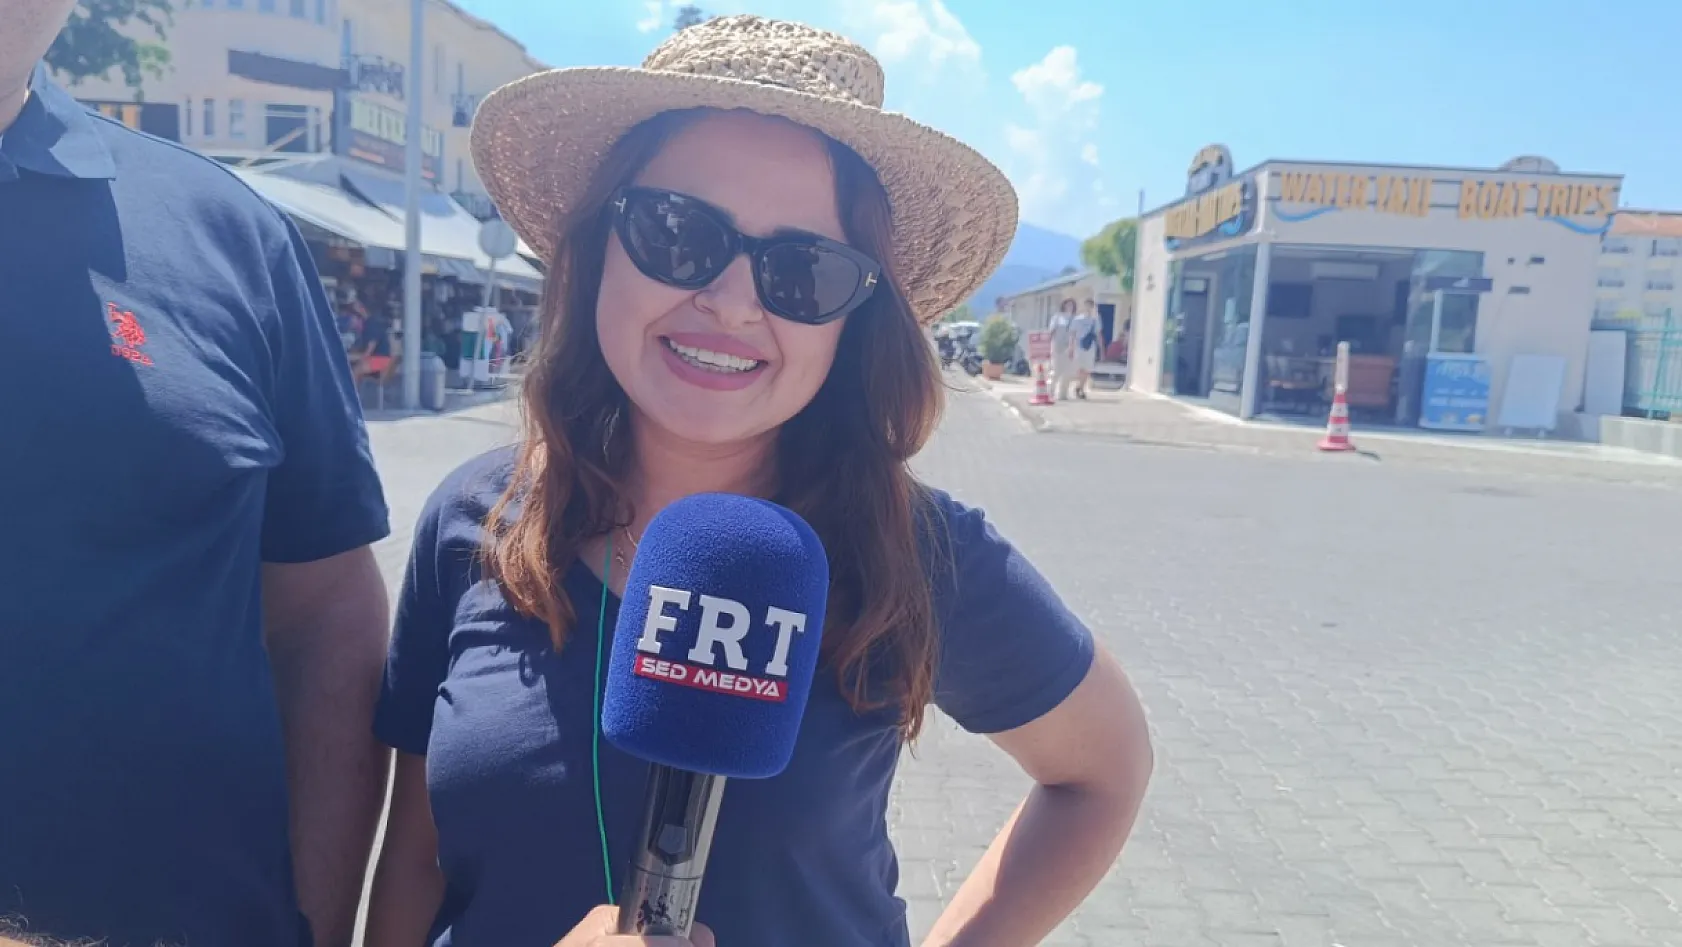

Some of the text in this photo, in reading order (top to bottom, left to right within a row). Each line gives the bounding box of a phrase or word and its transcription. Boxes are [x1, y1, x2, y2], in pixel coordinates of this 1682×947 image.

[1281, 172, 1367, 210] WATER
[1375, 175, 1432, 217] TAXI
[1458, 179, 1528, 220] BOAT
[1535, 181, 1616, 220] TRIPS
[637, 584, 807, 677] FRT
[640, 659, 780, 697] SED MEDYA
